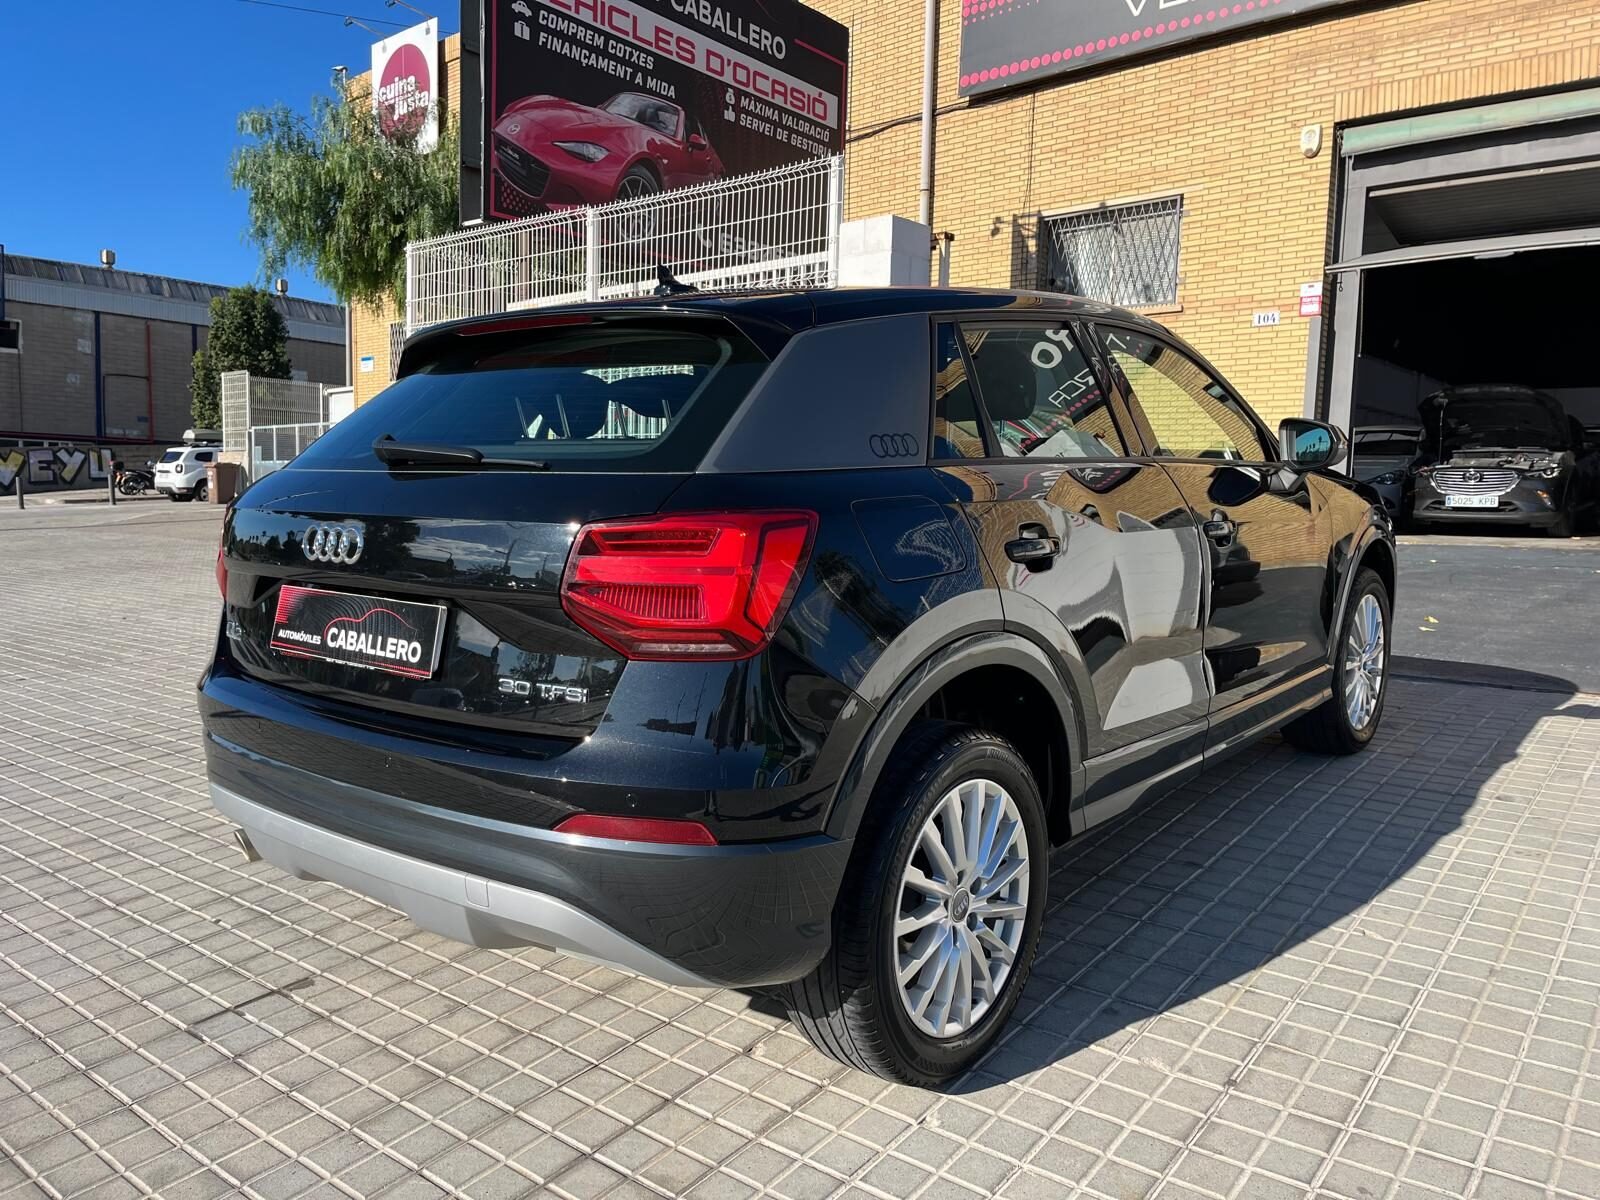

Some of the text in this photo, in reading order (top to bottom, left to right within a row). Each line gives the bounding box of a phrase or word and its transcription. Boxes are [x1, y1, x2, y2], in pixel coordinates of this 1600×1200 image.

[538, 9, 655, 70] COMPREM COTXES
[538, 31, 676, 99] FINANÇAMENT A MIDA
[379, 75, 416, 102] cuina
[705, 48, 828, 122] D'OCASIÓ
[739, 114, 774, 137] SERVEI
[776, 127, 789, 143] DE
[740, 96, 831, 143] MÀXIMA VALORACIÓ
[1257, 313, 1277, 325] 104
[1452, 496, 1474, 505] 5025
[277, 626, 422, 663] AUTOMÓVILES CABALLERO
[498, 678, 589, 703] 30 TFSI
